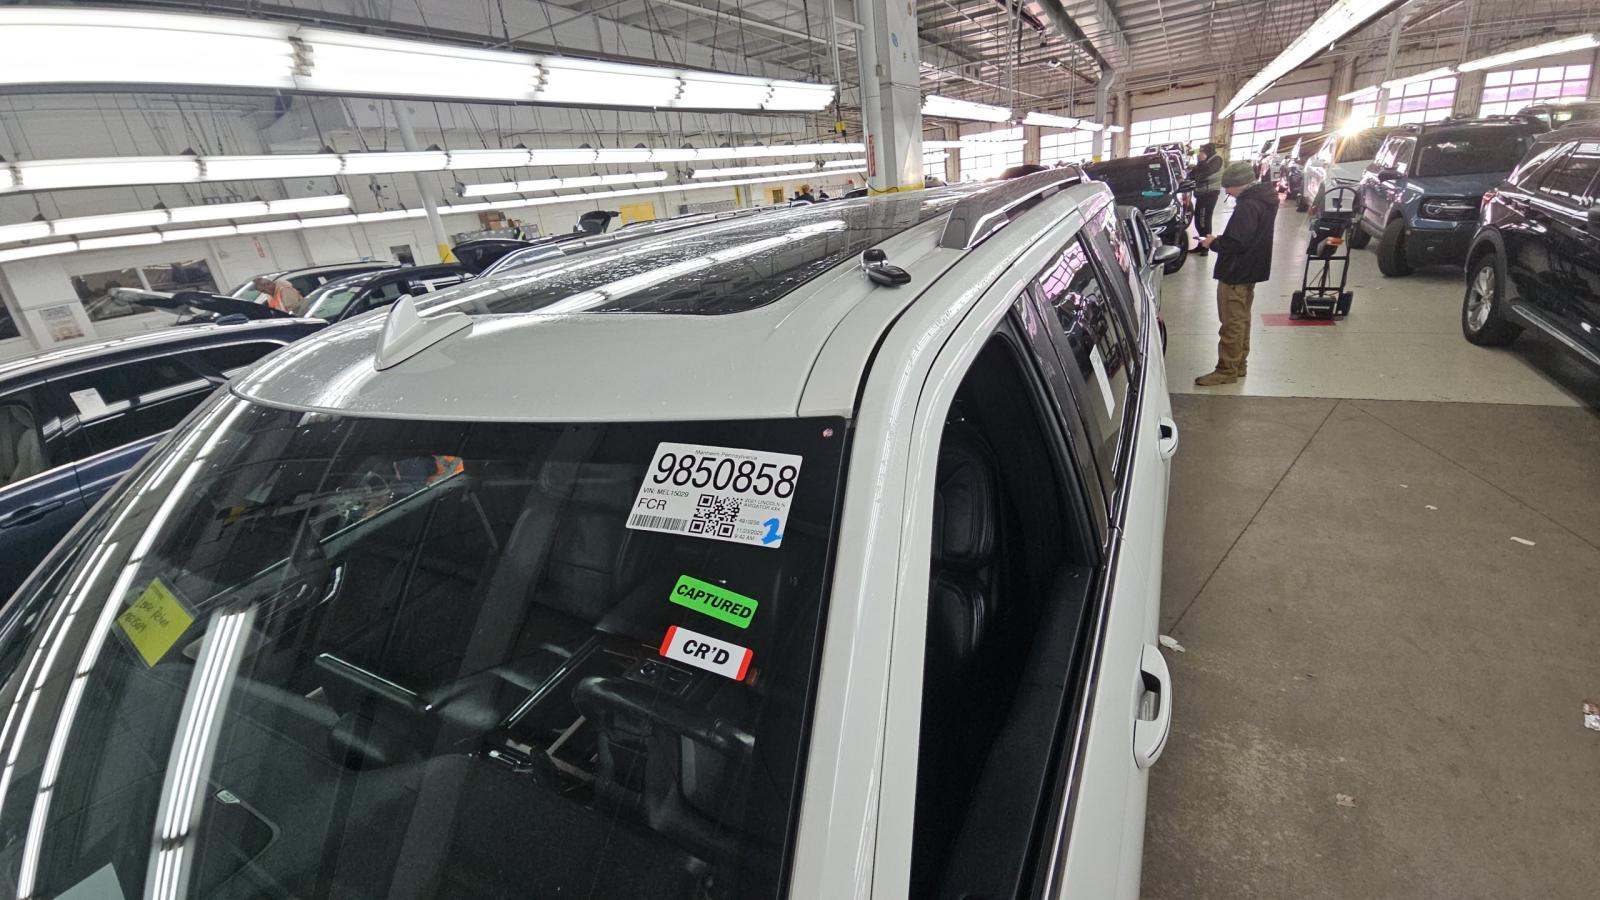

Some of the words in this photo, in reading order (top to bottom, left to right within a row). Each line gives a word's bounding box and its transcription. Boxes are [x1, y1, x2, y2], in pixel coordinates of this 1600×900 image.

[653, 452, 798, 499] 9850858
[637, 497, 667, 511] FCR
[676, 584, 752, 619] CAPTURED
[682, 639, 730, 665] CR'D
